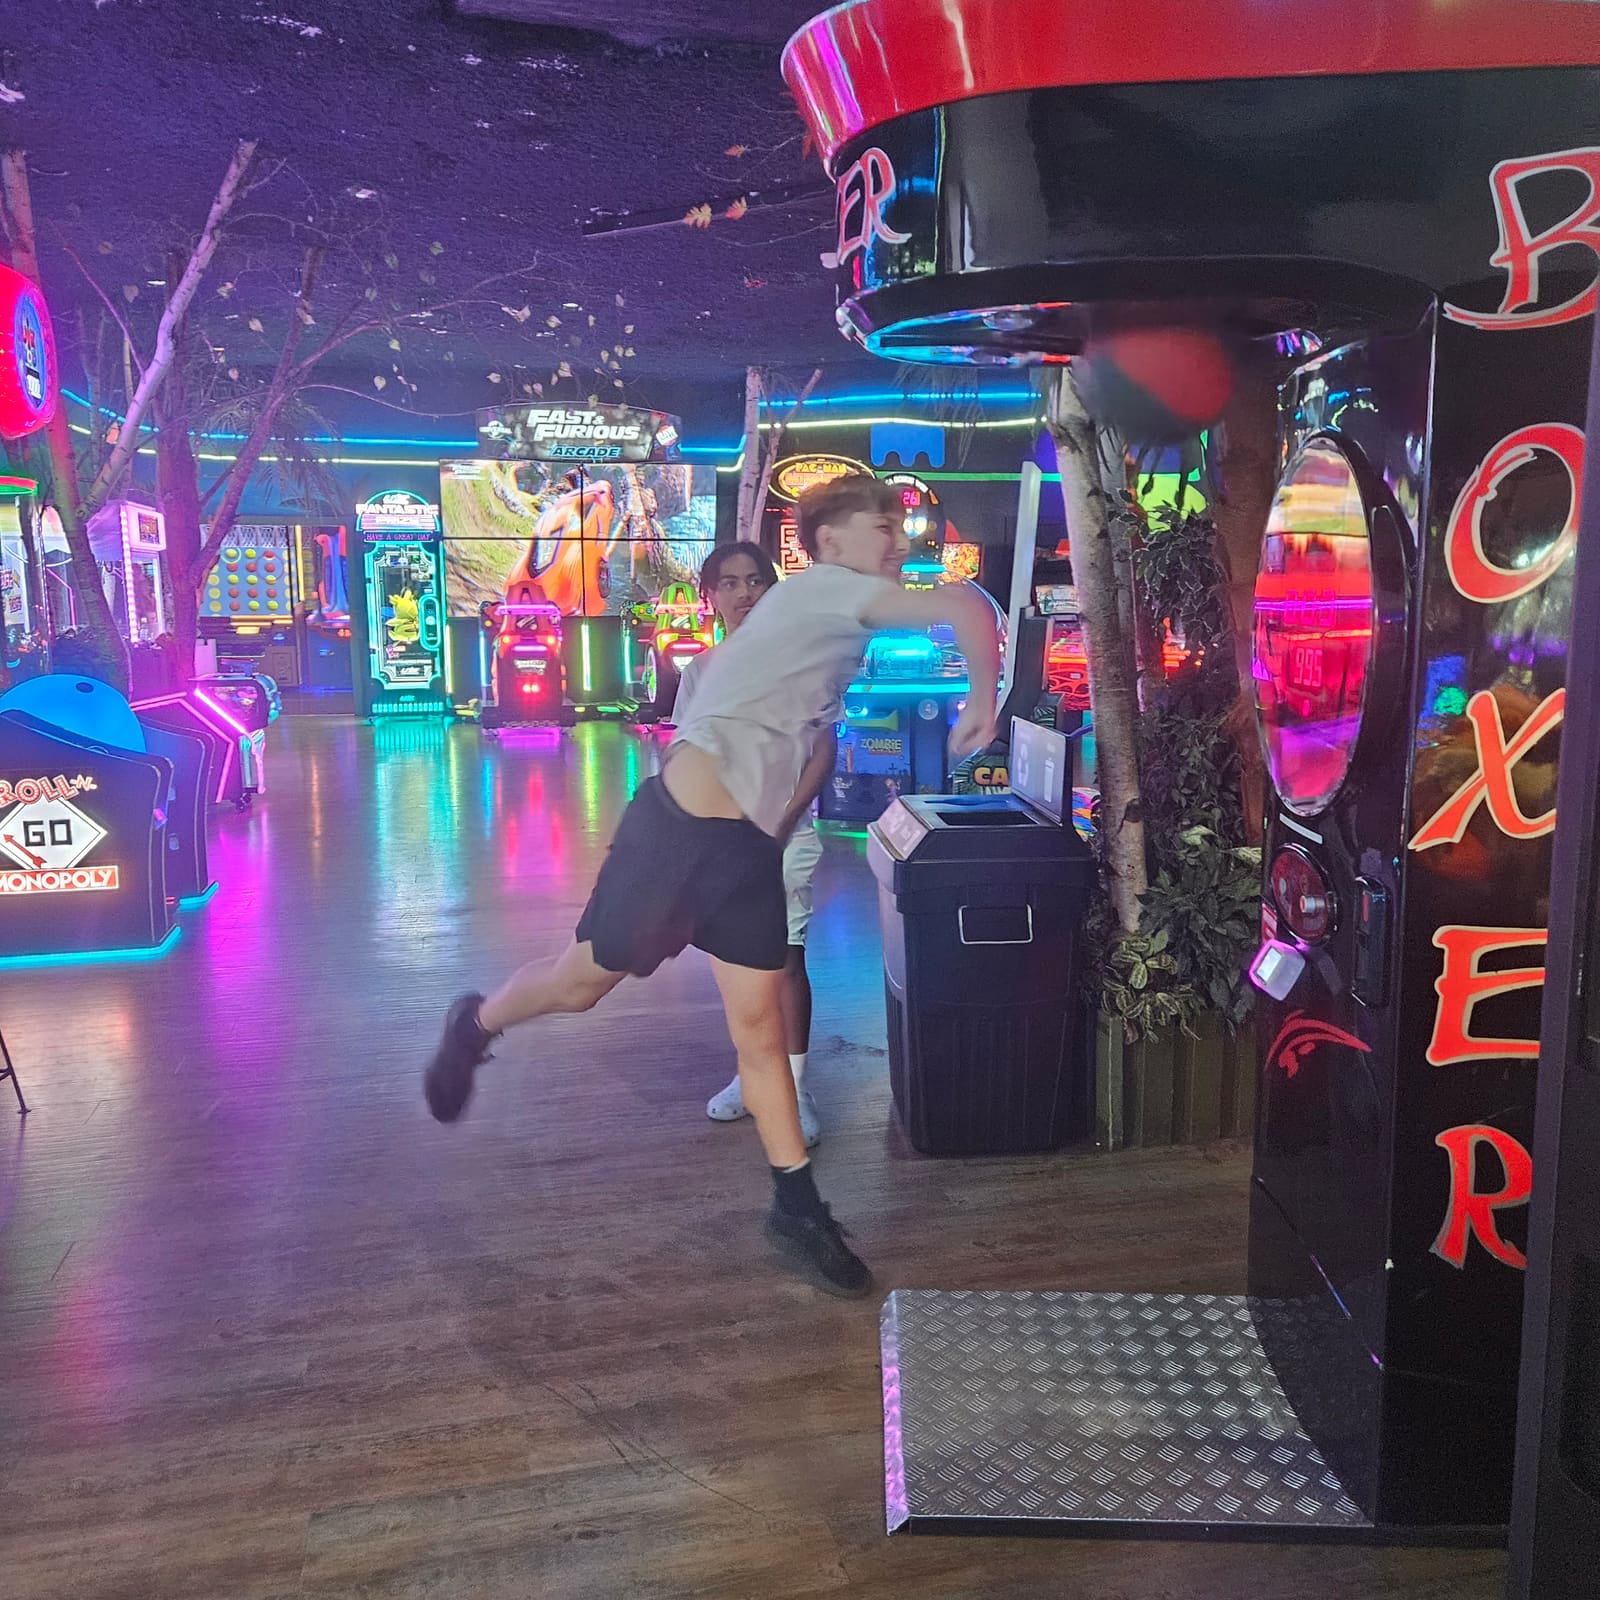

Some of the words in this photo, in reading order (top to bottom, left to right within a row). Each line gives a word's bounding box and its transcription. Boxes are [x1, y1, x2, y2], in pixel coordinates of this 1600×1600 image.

[533, 425, 641, 442] FURIOUS
[552, 447, 618, 458] ARCADE
[356, 504, 439, 515] FANTASTIC
[861, 739, 902, 750] ZOMBIE
[23, 819, 73, 847] GO
